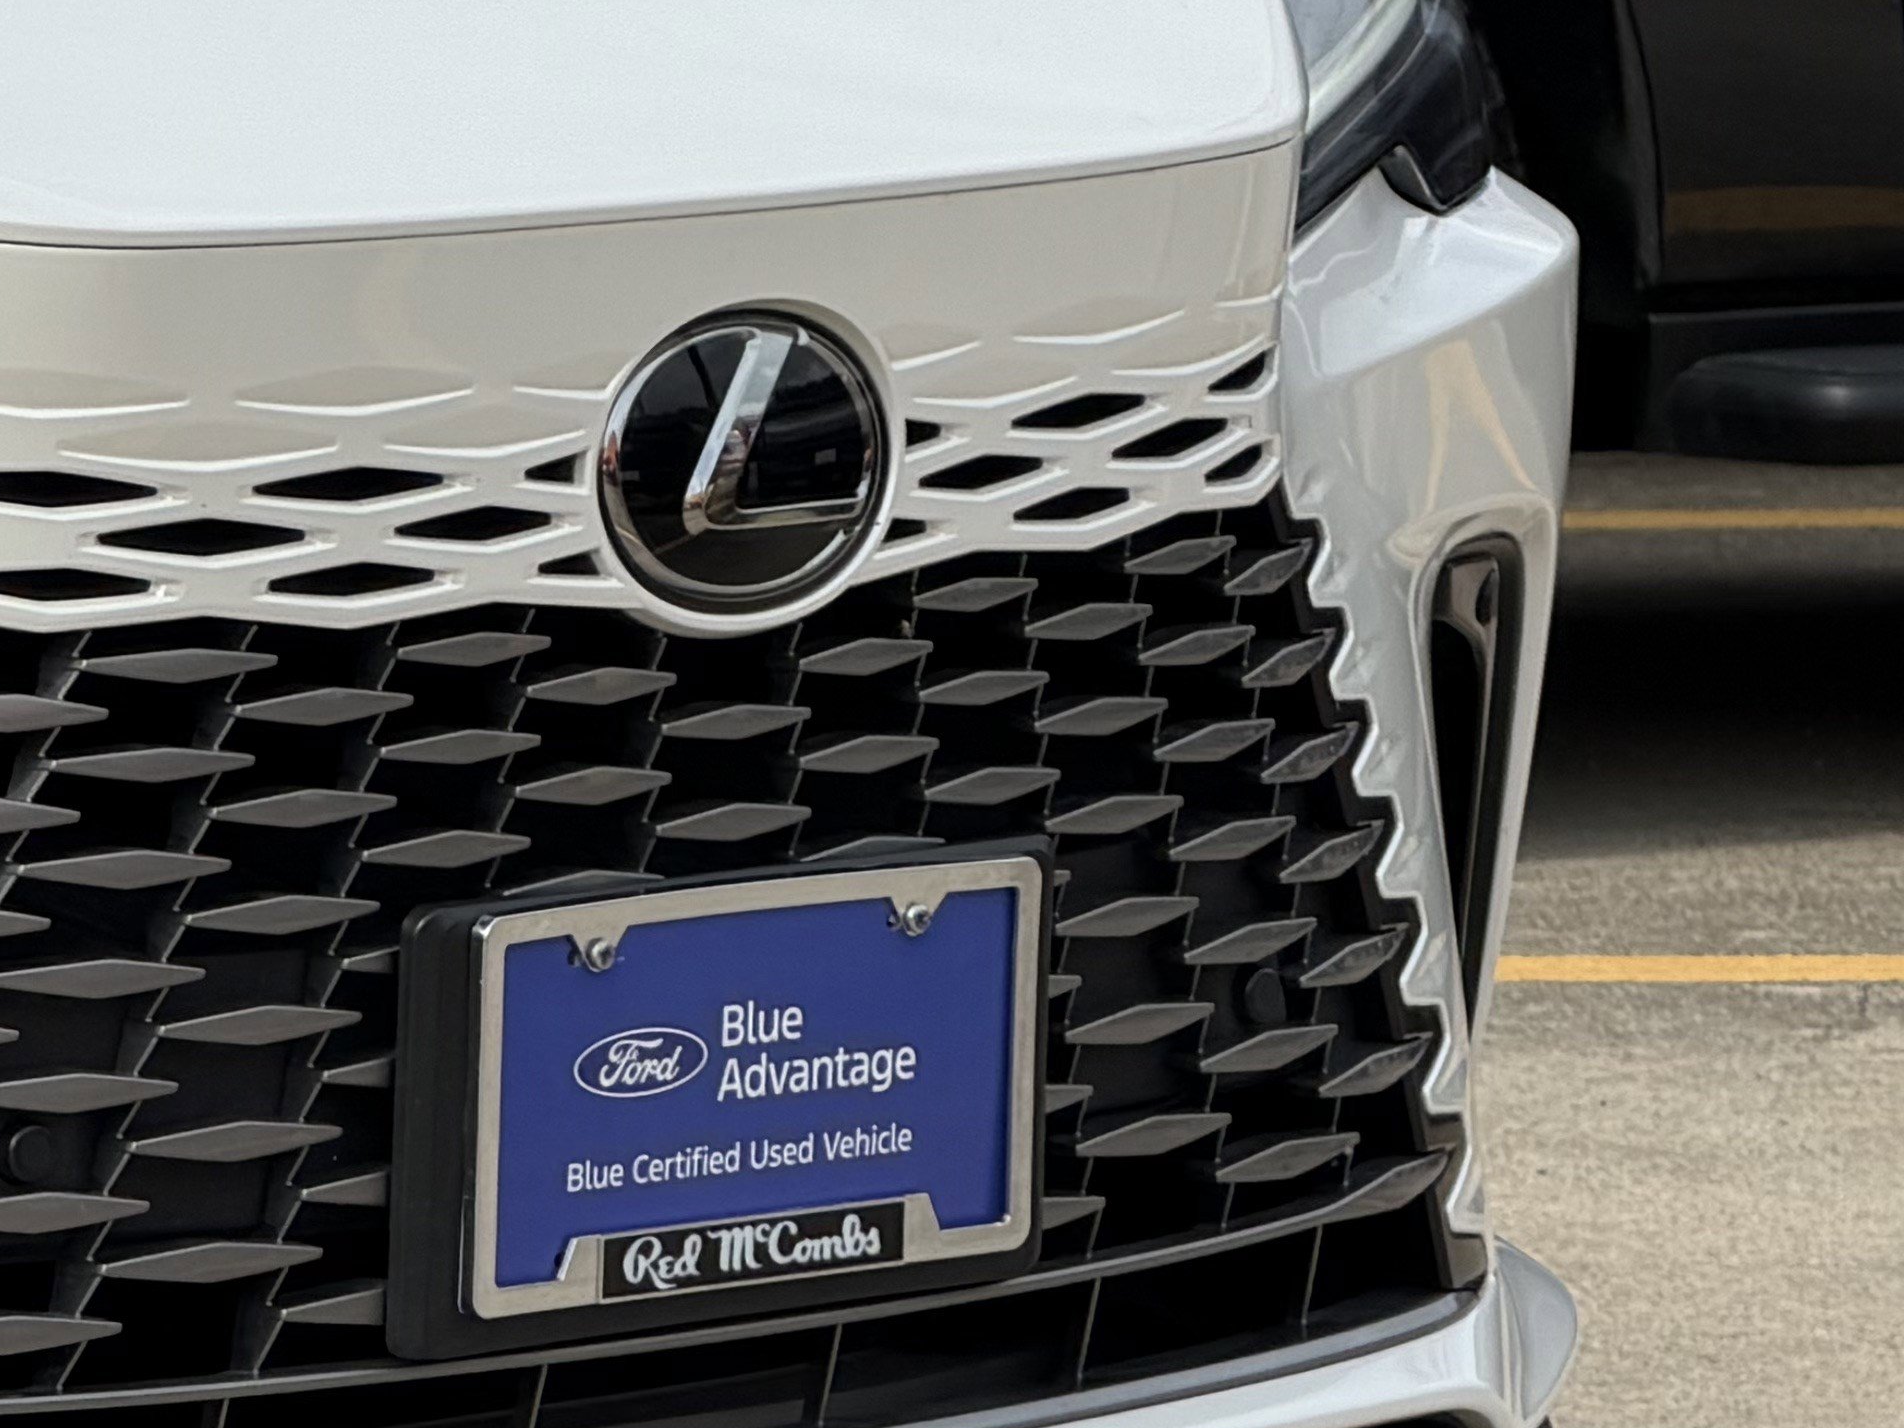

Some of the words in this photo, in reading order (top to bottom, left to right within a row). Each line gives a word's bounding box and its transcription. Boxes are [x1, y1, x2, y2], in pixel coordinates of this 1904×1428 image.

[721, 1000, 804, 1048] Blue
[598, 1037, 681, 1090] Ford
[717, 1044, 916, 1102] Advantage
[565, 1157, 625, 1194] Blue
[632, 1139, 741, 1185] Certified
[750, 1130, 815, 1171] Used
[823, 1122, 913, 1162] Vehicle
[622, 1234, 702, 1290] Red
[710, 1212, 882, 1274] McCombs
